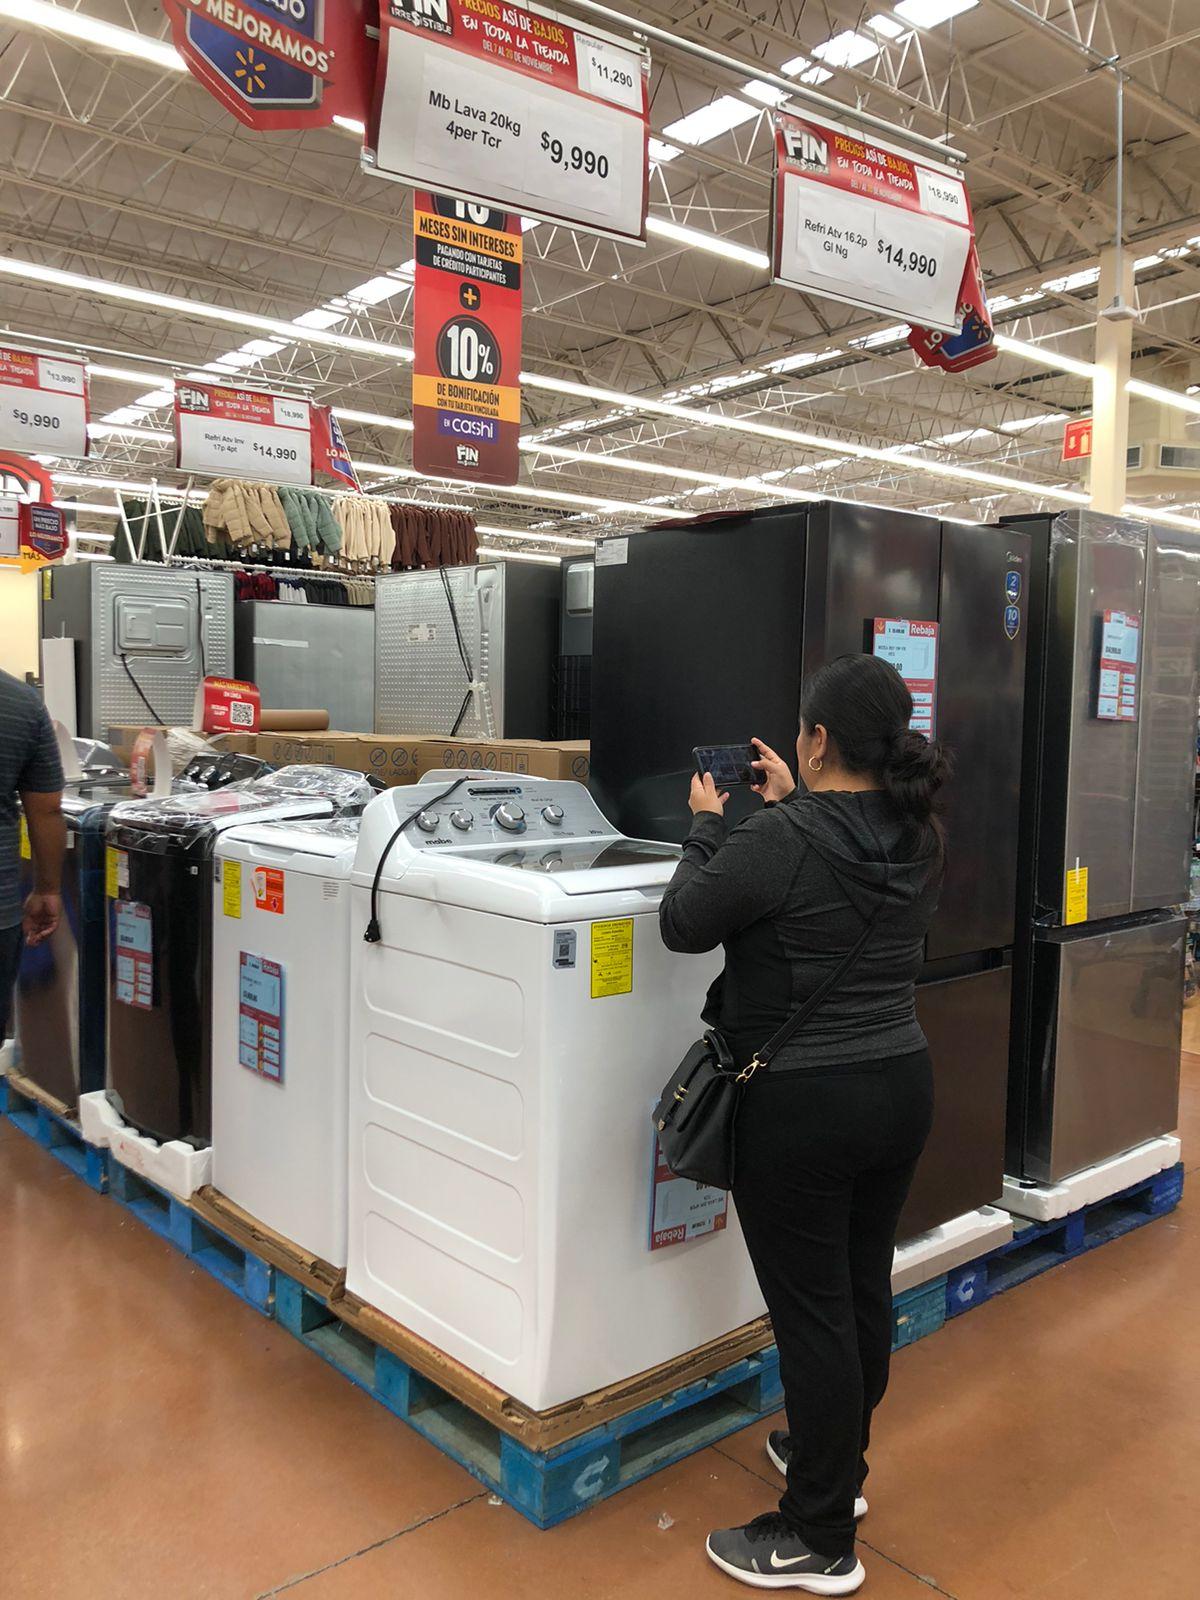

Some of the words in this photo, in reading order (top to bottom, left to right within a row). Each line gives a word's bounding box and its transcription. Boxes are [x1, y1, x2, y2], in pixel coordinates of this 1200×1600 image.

[502, 9, 518, 27] ASÍ
[520, 14, 533, 34] DE
[461, 15, 479, 30] EN
[483, 21, 512, 44] TODA
[517, 35, 529, 50] LA
[532, 40, 571, 65] TIENDA
[592, 56, 633, 88] $11,290
[429, 90, 451, 111] Mb
[455, 98, 487, 123] Lava
[490, 111, 521, 137] 20kg
[446, 120, 479, 143] 4per
[481, 130, 503, 150] Tcr
[782, 130, 828, 166] FIN
[540, 130, 609, 179] $9,990
[878, 153, 888, 167] DE
[852, 161, 872, 176] TODA
[875, 170, 885, 181] LA
[887, 173, 915, 191] TIENDA
[419, 216, 450, 239] MESES
[451, 225, 468, 244] SIN
[804, 219, 826, 235] Refri
[827, 226, 843, 240] Atv
[844, 230, 868, 249] 16.2p
[437, 243, 464, 260] PAGANDO
[477, 254, 503, 271] TARJETAS
[836, 243, 848, 259] Ng
[877, 239, 937, 278] $14,990
[432, 255, 441, 267] DE
[465, 263, 507, 285] PARTICIPANTES
[446, 324, 493, 381] 10%
[179, 389, 209, 407] FIN
[437, 382, 446, 396] DE
[448, 384, 500, 406] BONIFICACIÓN
[13, 409, 60, 429] $9,990
[452, 418, 493, 439] cashi
[253, 440, 298, 461] $14,990
[911, 624, 935, 636] Rebaja
[425, 837, 453, 846] mabe
